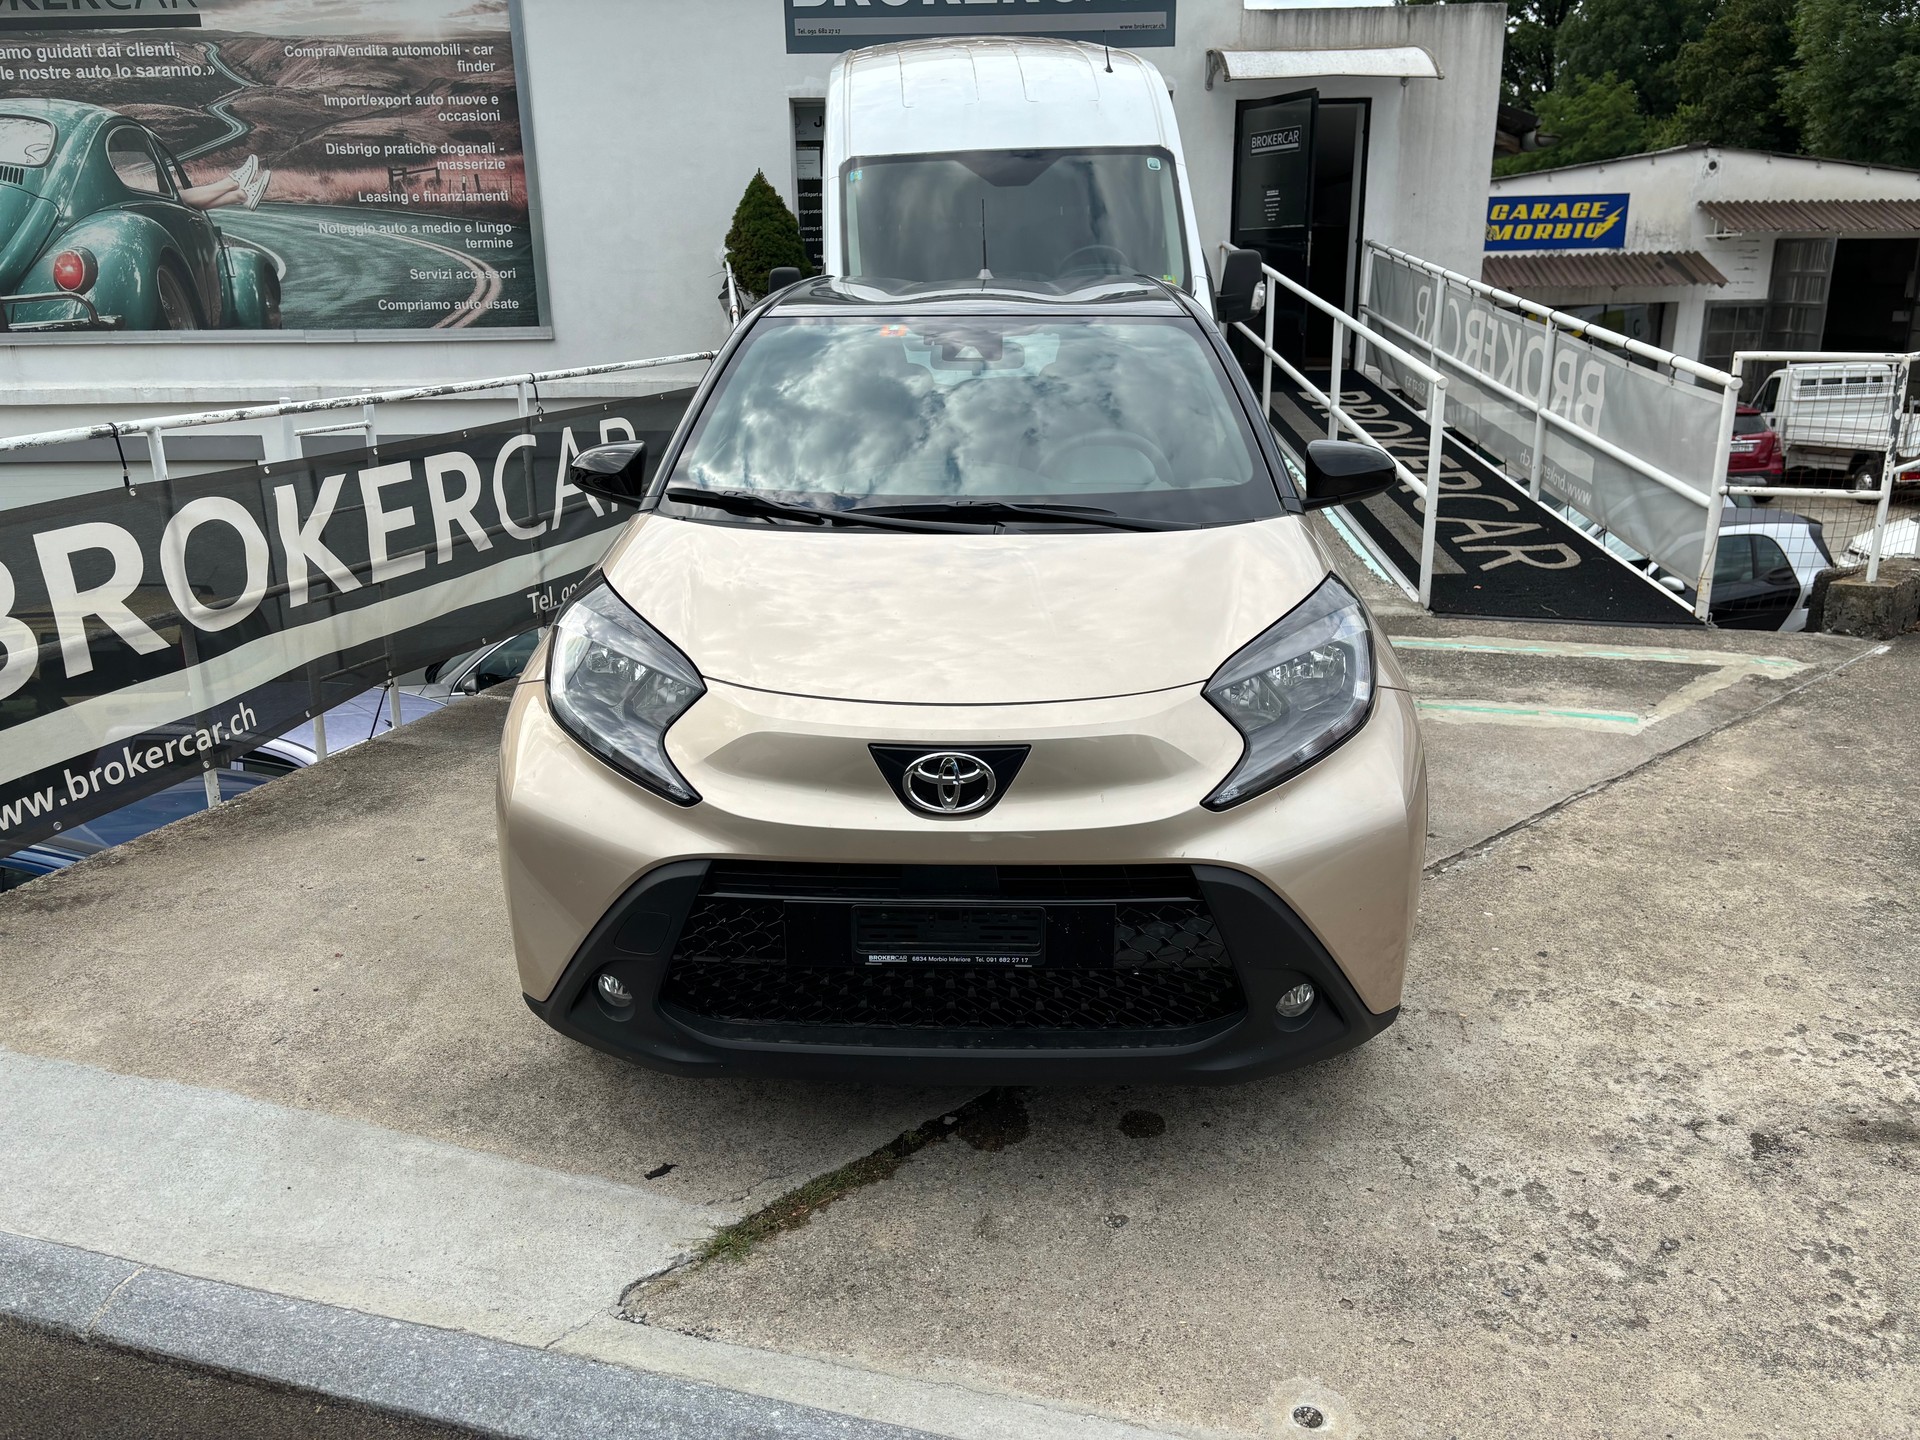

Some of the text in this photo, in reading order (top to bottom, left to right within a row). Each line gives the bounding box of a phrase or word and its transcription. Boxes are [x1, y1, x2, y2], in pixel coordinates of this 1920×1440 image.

[1119, 22, 1166, 30] www.brokercar.ch
[36, 43, 92, 62] guidati
[97, 42, 121, 58] dai
[126, 41, 180, 59] clienti,
[284, 45, 388, 59] Compra/Vendita
[391, 43, 461, 57] automobili
[473, 45, 494, 56] car
[0, 63, 216, 80] le nostre auto lo saranno.»
[457, 60, 496, 72] finder
[323, 94, 499, 108] Import/export auto nuove e
[438, 109, 501, 121] occasioni
[1251, 130, 1300, 148] BROKERCAR
[325, 143, 381, 157] Disbrigo
[384, 142, 437, 157] pratiche
[440, 141, 496, 156] doganali
[437, 158, 506, 170] masserizie
[358, 190, 509, 204] Leasing e finanziamenti
[1489, 201, 1610, 221] GARAGE
[318, 222, 513, 236] Noleggio auto a medio e lungo
[465, 237, 514, 249] termine
[410, 268, 516, 280] Servizi accessori
[378, 298, 520, 312] Compriamo auto usate
[526, 585, 557, 613] Tel.
